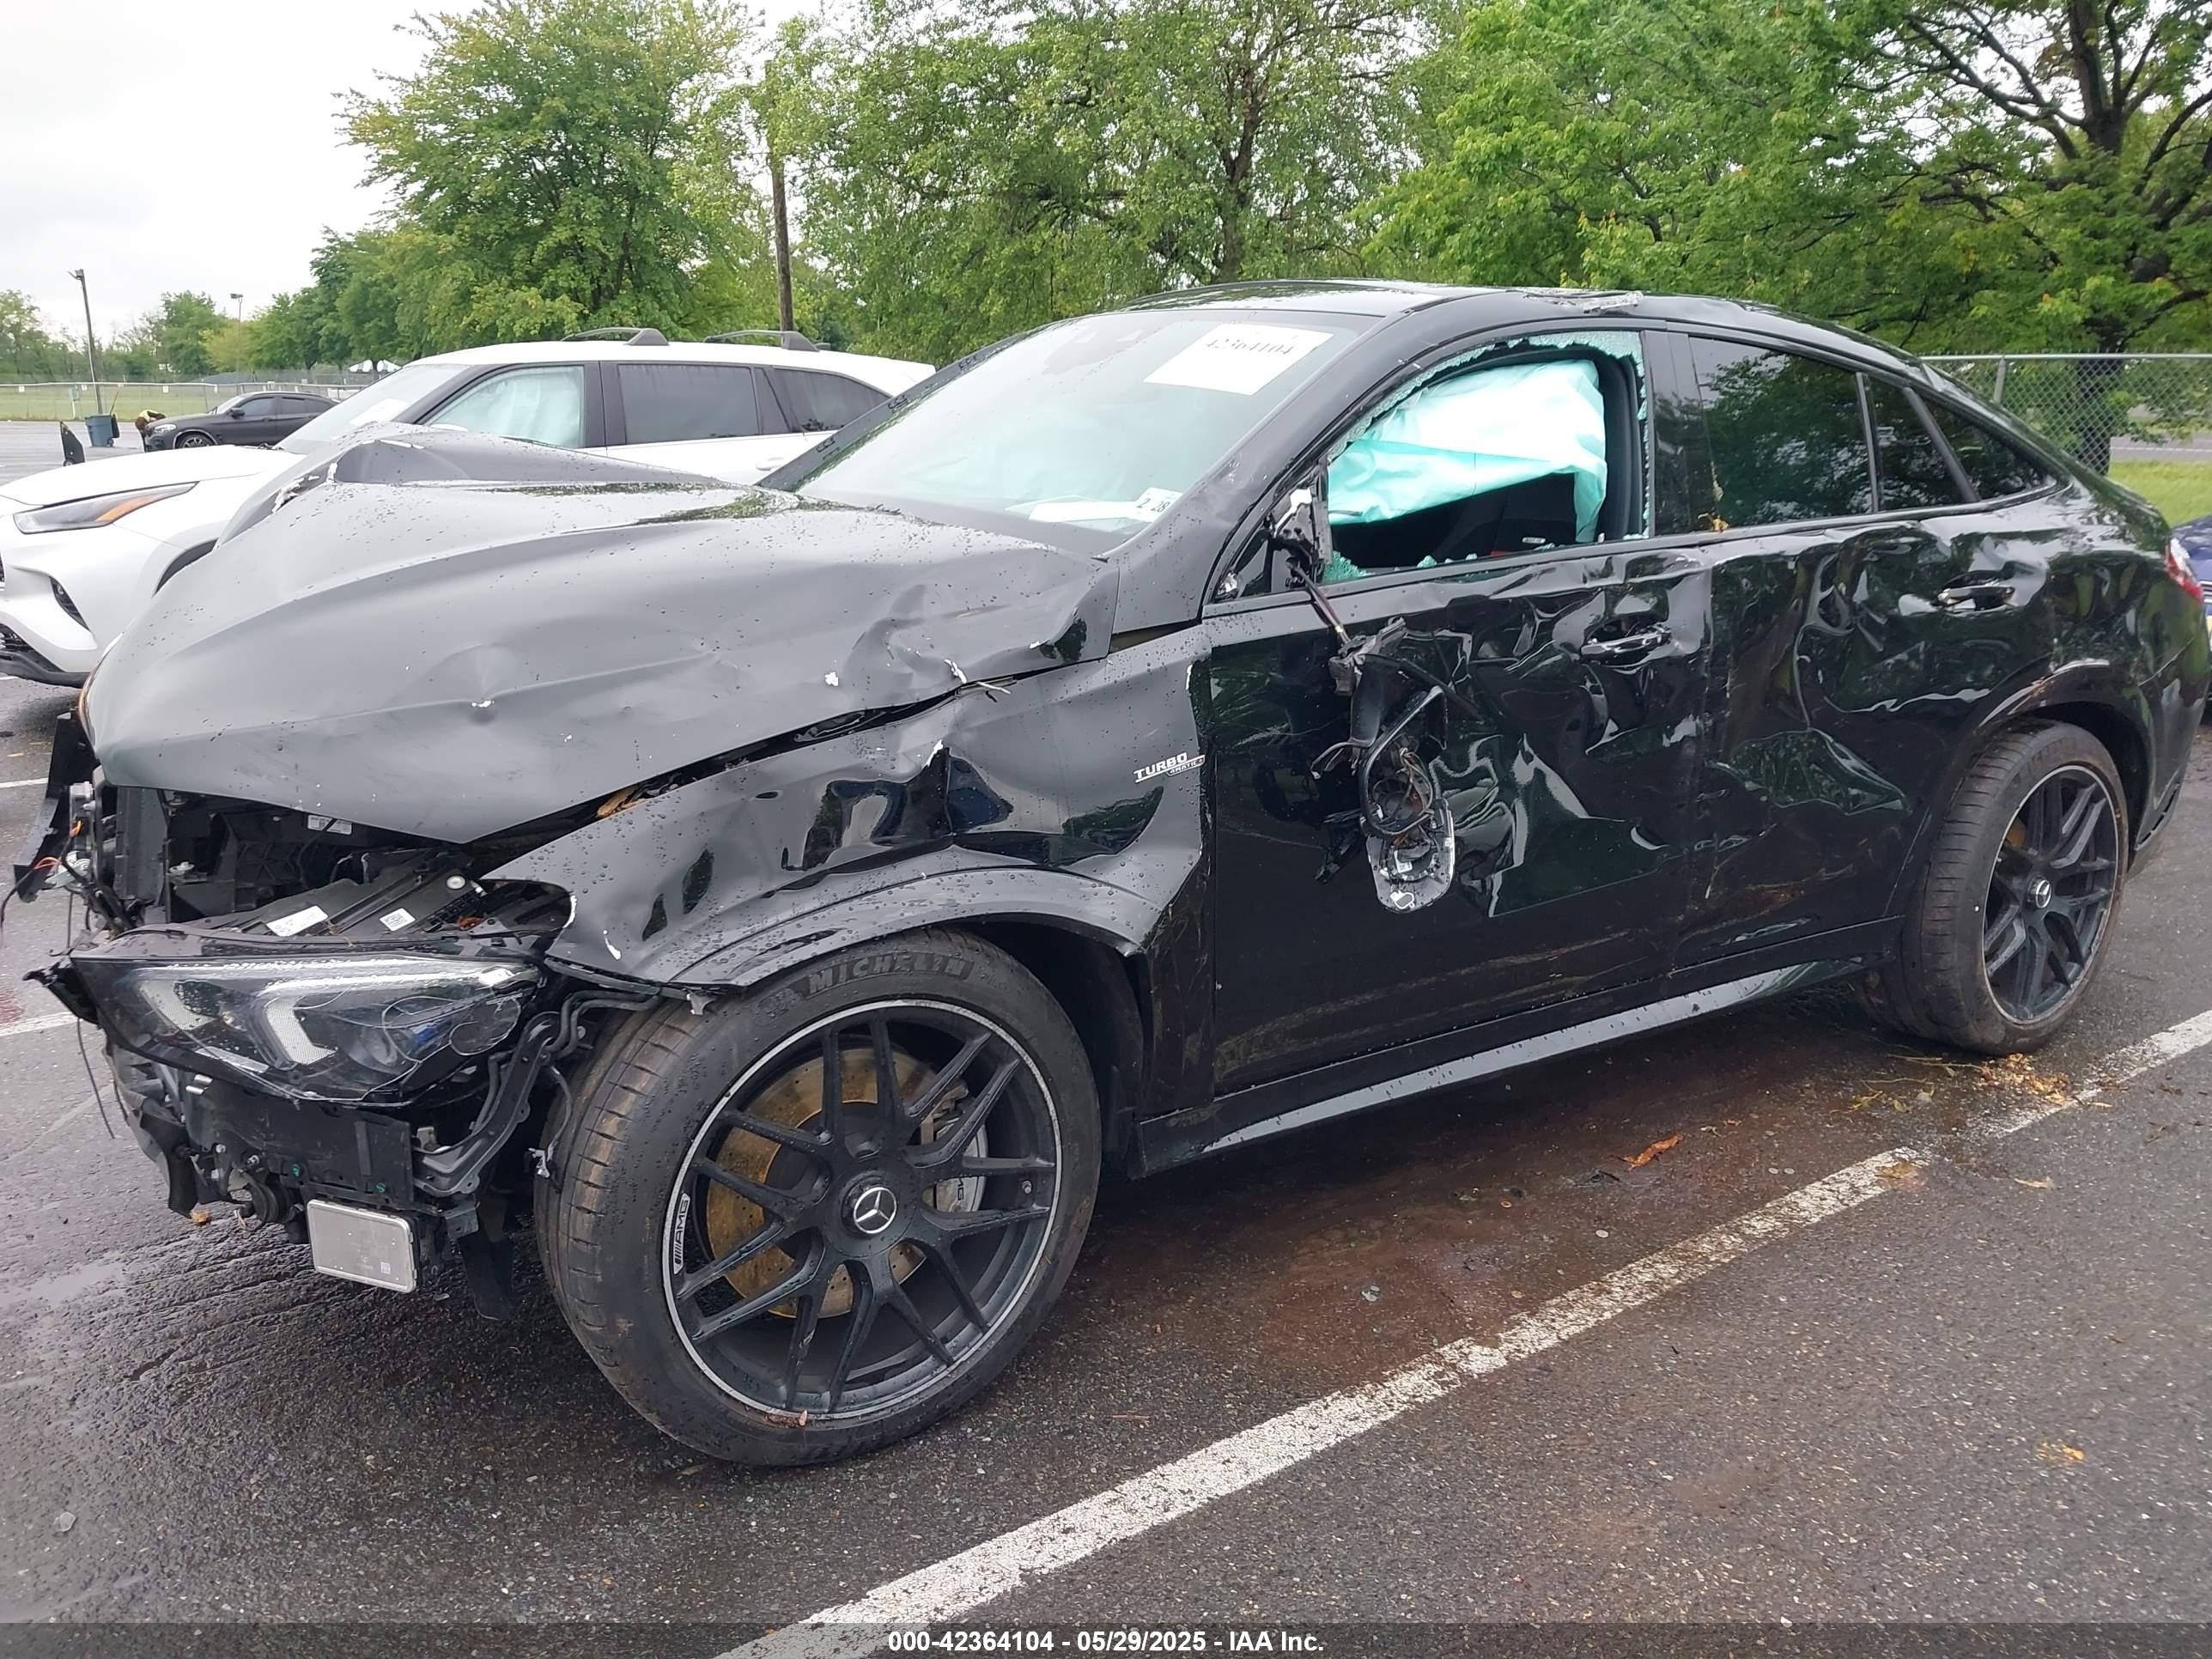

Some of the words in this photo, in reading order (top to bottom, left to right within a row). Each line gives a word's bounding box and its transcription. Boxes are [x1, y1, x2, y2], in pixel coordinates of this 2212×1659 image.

[1133, 752, 1187, 779] TURBO
[809, 953, 966, 994] MICHELIN
[675, 1200, 689, 1246] AMG
